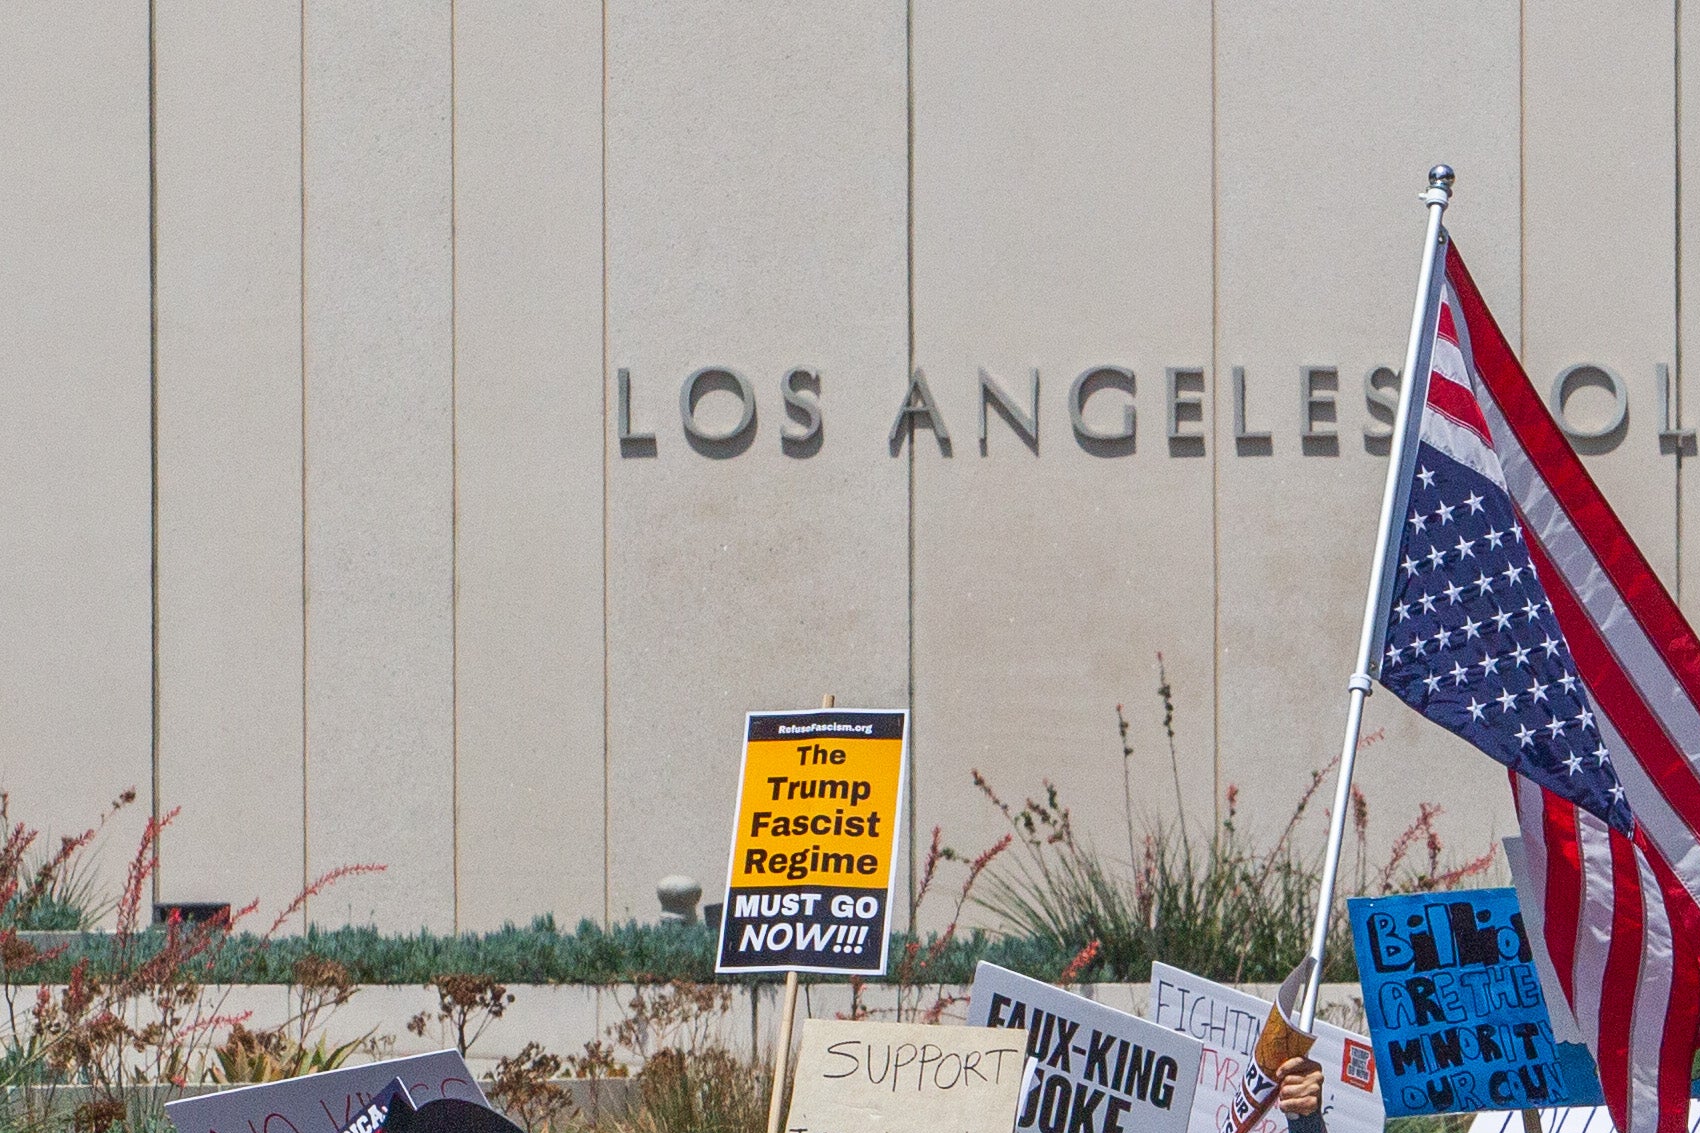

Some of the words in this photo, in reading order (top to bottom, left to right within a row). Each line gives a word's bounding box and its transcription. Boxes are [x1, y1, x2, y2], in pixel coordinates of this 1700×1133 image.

[616, 366, 824, 456] LOS
[889, 366, 1402, 457] ANGELES
[778, 723, 873, 735] RefuseFascism.org
[797, 744, 847, 766] The
[767, 776, 871, 807] Trump
[750, 809, 881, 838] Fascist
[744, 845, 878, 880] Regime
[734, 893, 821, 918] MUST
[831, 896, 878, 919] GO
[739, 923, 869, 954] NOW!!!
[1378, 972, 1468, 1029] ARE
[1460, 965, 1540, 1018] THE
[823, 1041, 1018, 1092] SUPPORT
[987, 992, 1178, 1111] FAUX-KING
[1401, 1070, 1485, 1112] OUR
